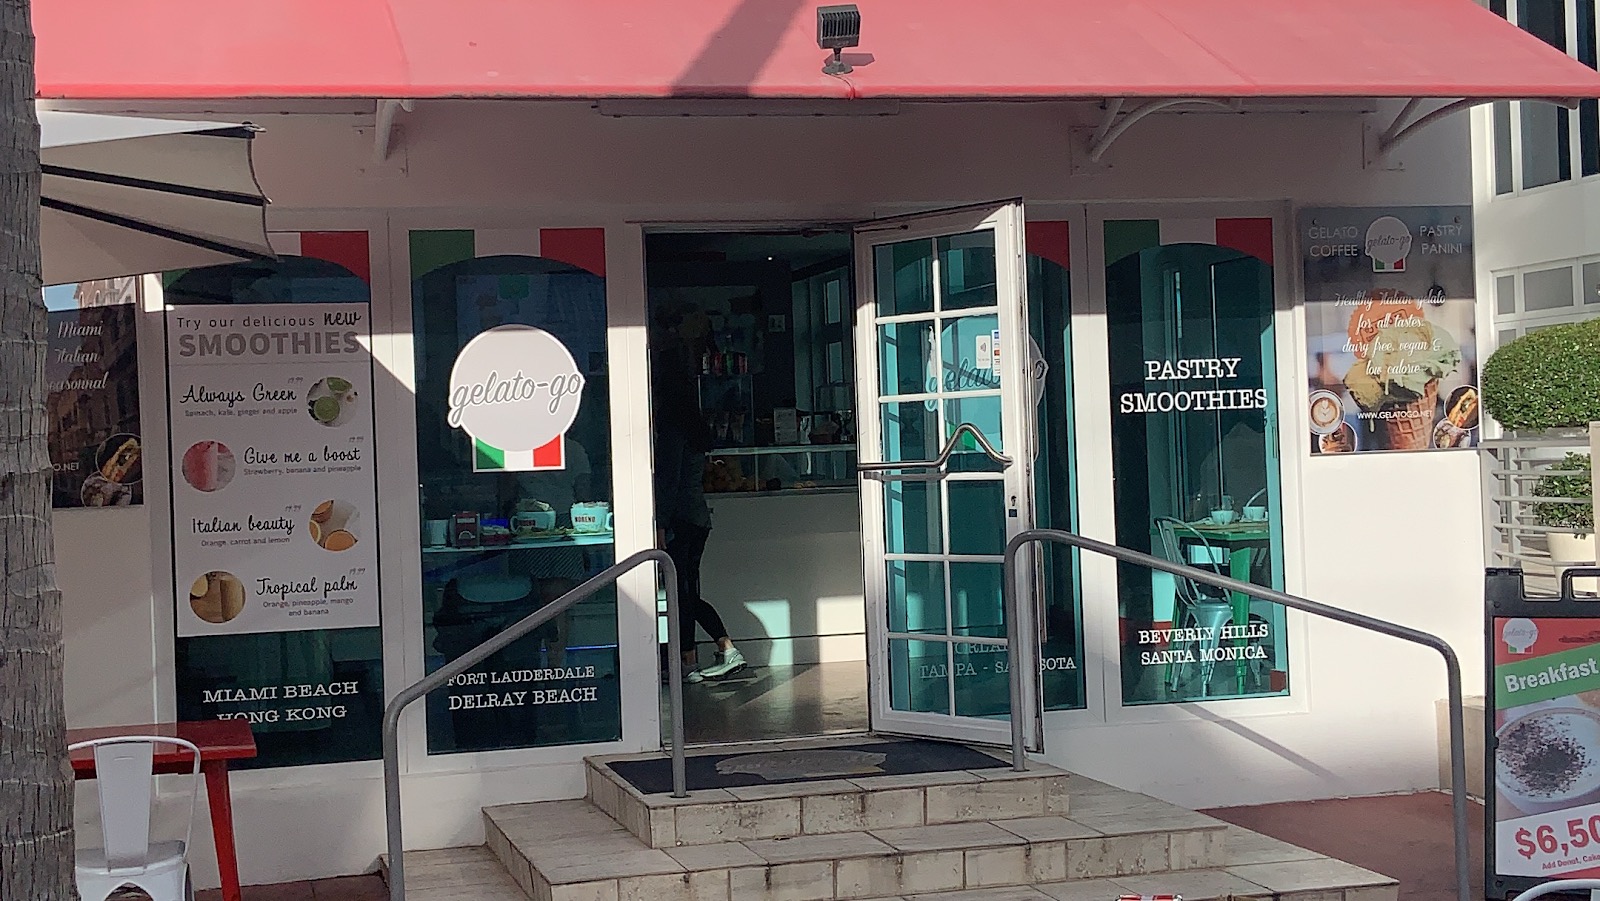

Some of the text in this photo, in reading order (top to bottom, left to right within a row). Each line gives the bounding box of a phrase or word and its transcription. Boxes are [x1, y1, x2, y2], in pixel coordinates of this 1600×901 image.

[1309, 227, 1357, 239] GELATO
[1420, 225, 1463, 237] PASTRY
[1310, 245, 1357, 257] COFFEE
[1421, 243, 1463, 254] PANINI
[57, 320, 103, 338] Miami
[177, 311, 361, 330] Try our delicious new
[1356, 313, 1372, 335] for
[1377, 313, 1390, 328] all
[179, 331, 359, 357] SMOOTHIES
[1342, 338, 1369, 358] dairy
[1400, 341, 1428, 358] vegan
[1432, 338, 1442, 352] &
[1145, 358, 1241, 380] PASTRY
[180, 383, 297, 408] Always Green
[450, 370, 585, 426] gelato-go
[1120, 389, 1268, 413] SMOOTHIES
[244, 446, 361, 464] Give me a boost
[192, 514, 295, 535] Italian beauty
[253, 536, 267, 545] and
[268, 536, 290, 544] lemon
[256, 574, 358, 600] Tropical palm
[303, 608, 329, 616] banana
[1138, 625, 1269, 644] BEVERLY HILLS
[1141, 646, 1268, 665] SANTA MONICA
[447, 666, 595, 686] FORT LAUDERDALE
[1504, 658, 1599, 693] Breakfast
[203, 681, 359, 703] MIAMI BEACH
[449, 687, 597, 710] DELRAY BEACH
[285, 705, 347, 721] KONG
[1542, 861, 1556, 870] Add
